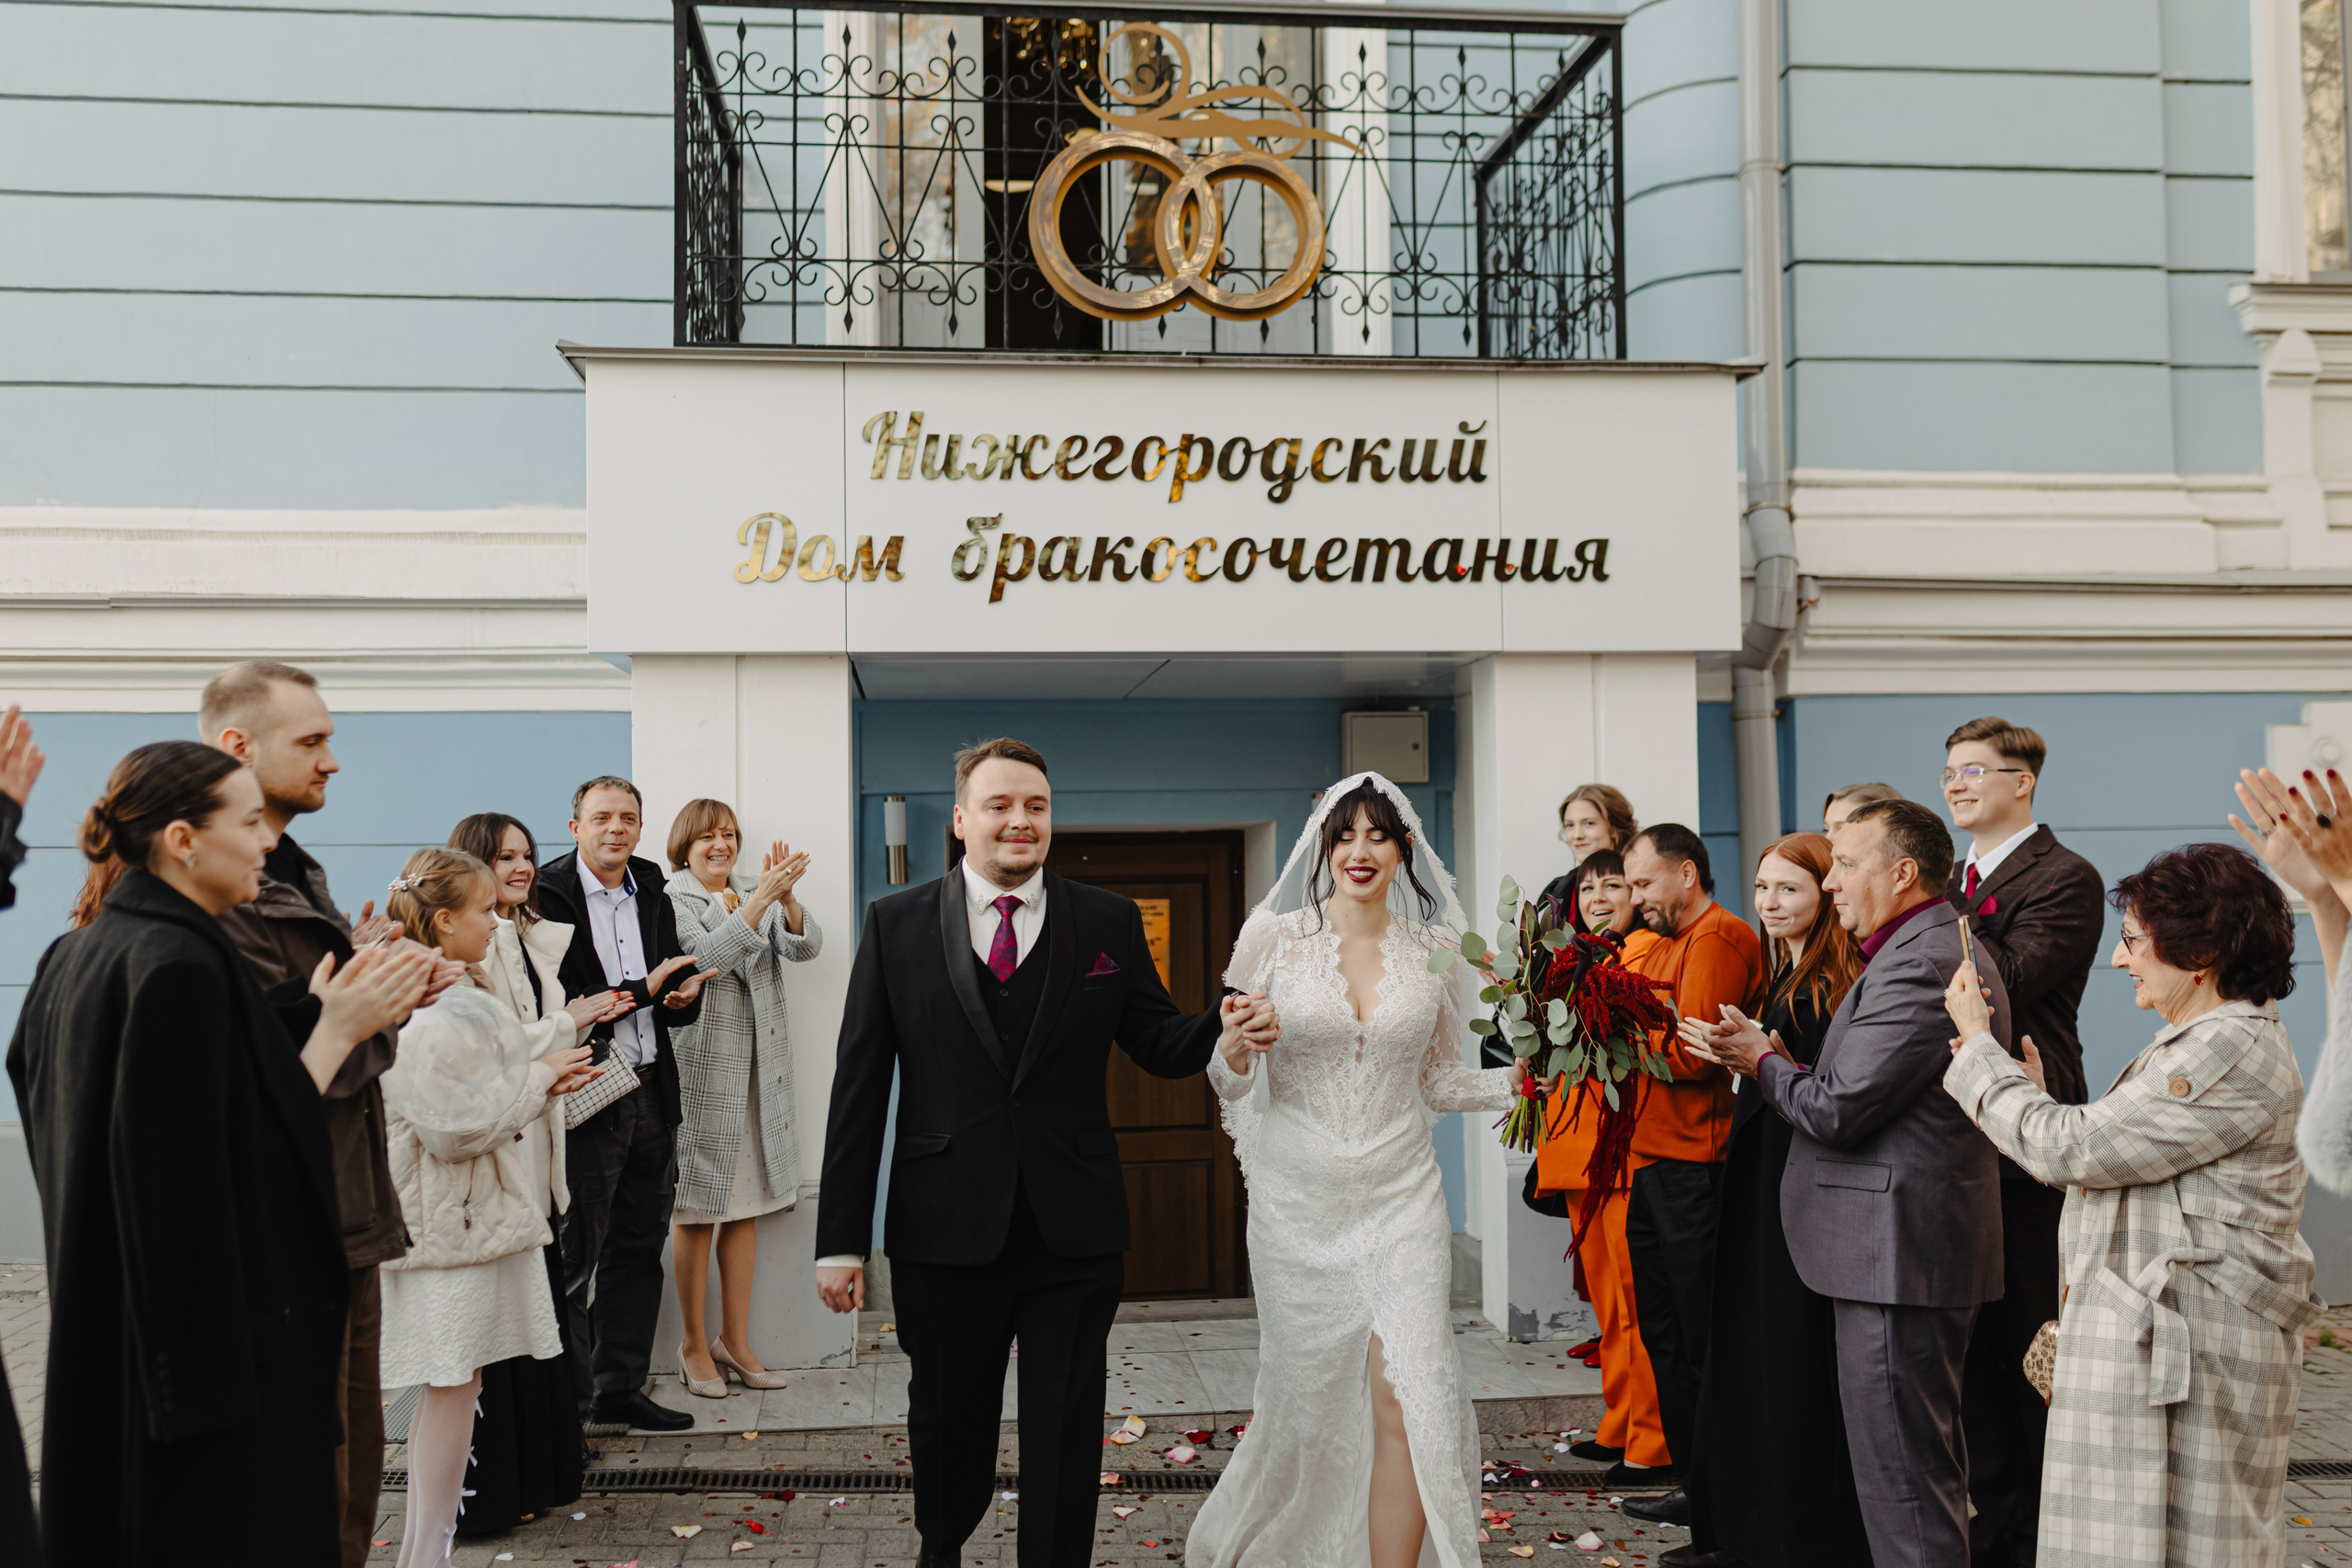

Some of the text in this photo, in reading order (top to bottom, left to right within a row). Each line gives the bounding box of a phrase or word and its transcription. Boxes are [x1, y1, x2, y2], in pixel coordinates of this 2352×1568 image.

[862, 411, 1487, 503] Нижегородский
[734, 512, 1610, 604] Дом бракосочетания
